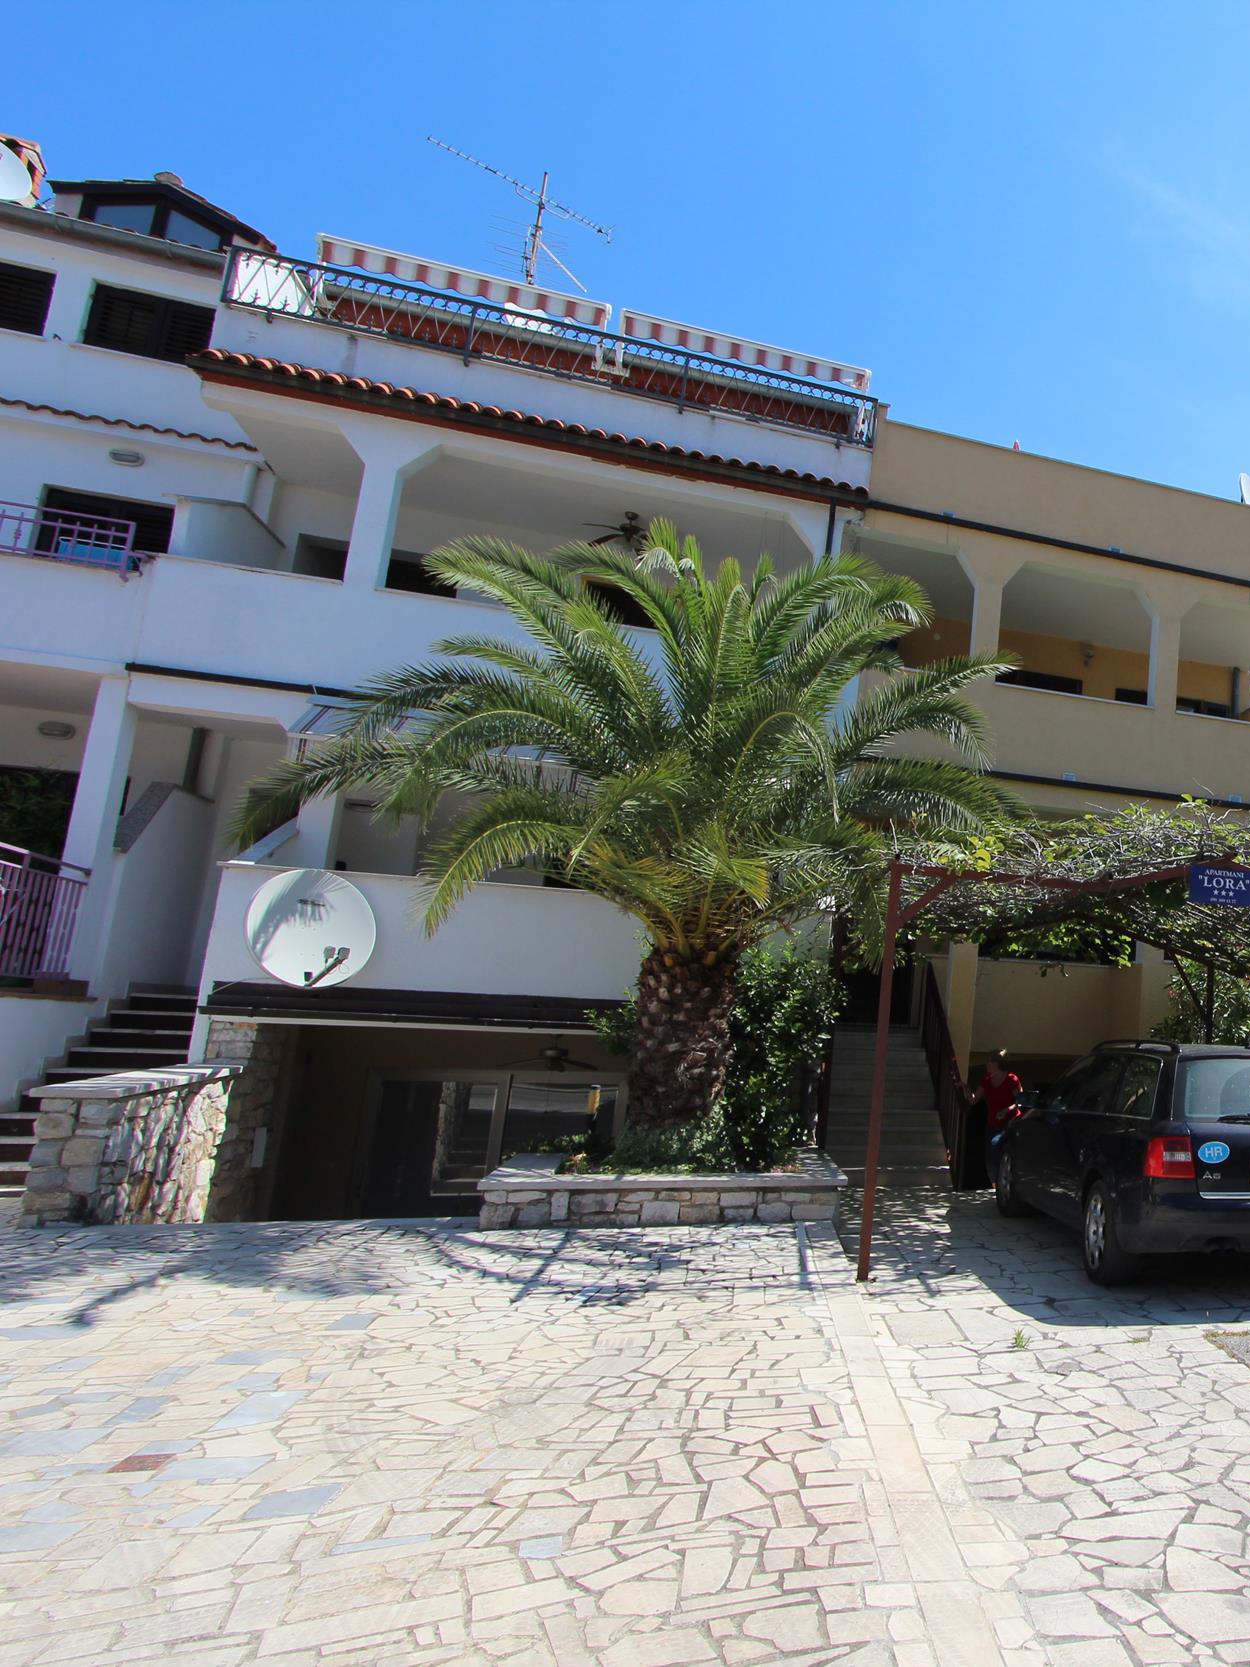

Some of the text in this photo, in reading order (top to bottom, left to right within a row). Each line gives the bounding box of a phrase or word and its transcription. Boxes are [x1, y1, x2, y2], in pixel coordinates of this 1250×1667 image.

[1204, 868, 1245, 879] APARTMANI
[1198, 874, 1250, 891] "LORA"
[1205, 1146, 1223, 1158] HR
